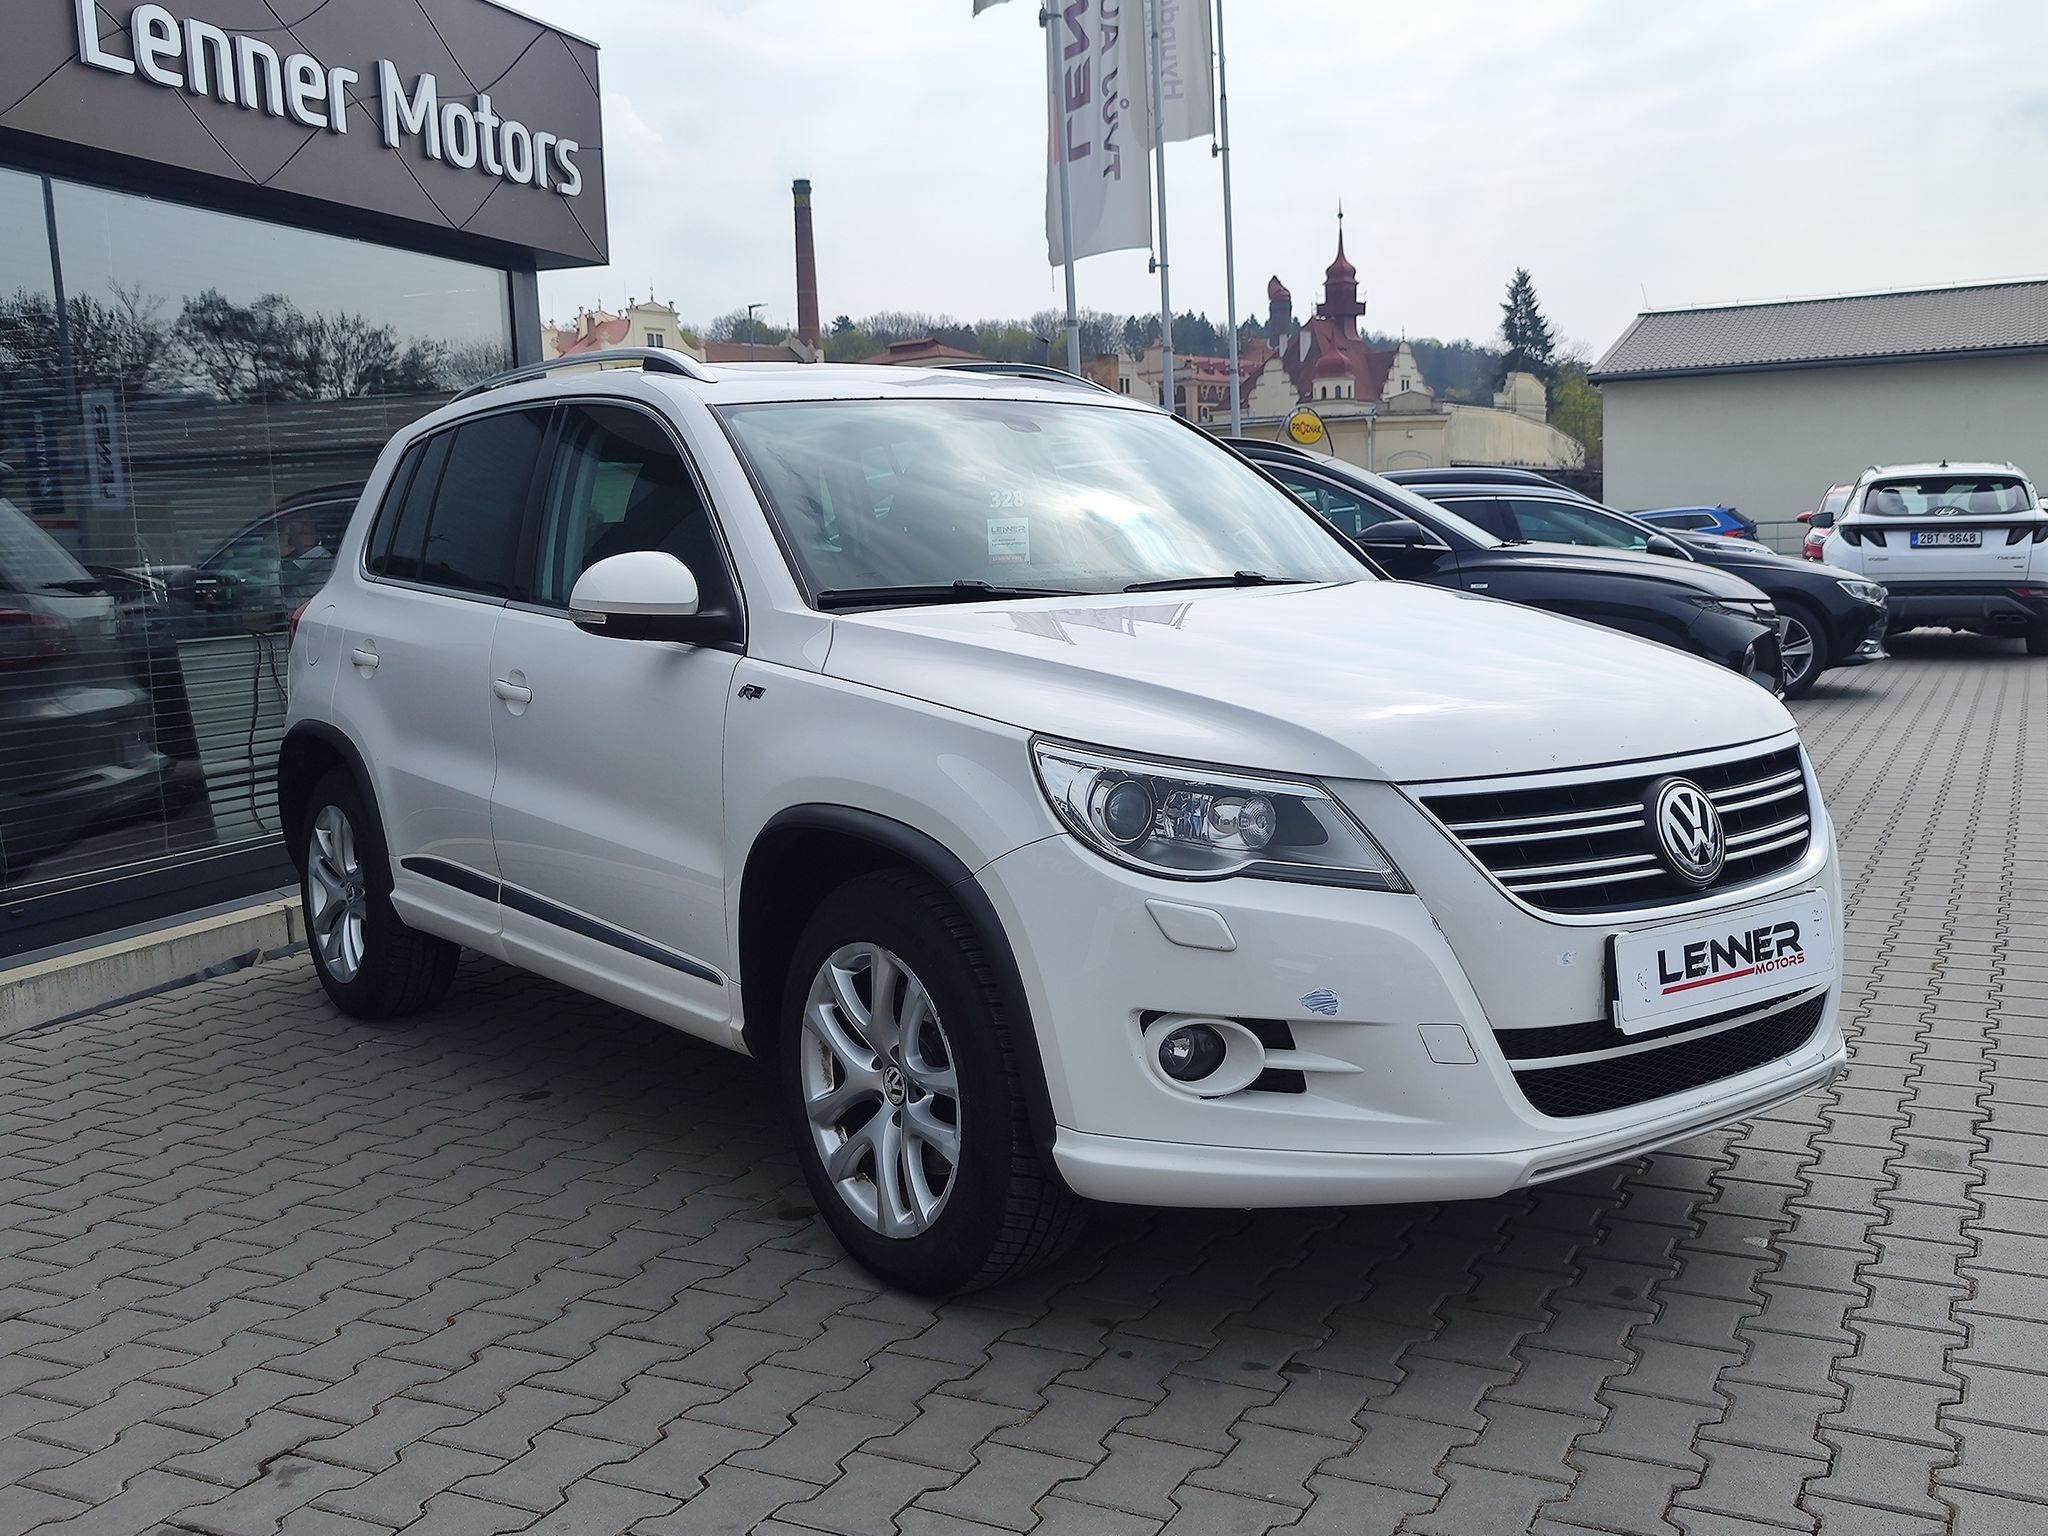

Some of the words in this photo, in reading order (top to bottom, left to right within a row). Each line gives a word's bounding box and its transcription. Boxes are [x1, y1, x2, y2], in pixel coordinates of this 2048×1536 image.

[75, 0, 359, 135] Lenner
[377, 59, 583, 197] Motors
[989, 489, 1024, 508] 328
[1920, 533, 1939, 544] 2BT
[1949, 533, 1976, 544] 9648
[1657, 920, 1804, 986] LENNER
[1755, 952, 1805, 975] MOTORS
